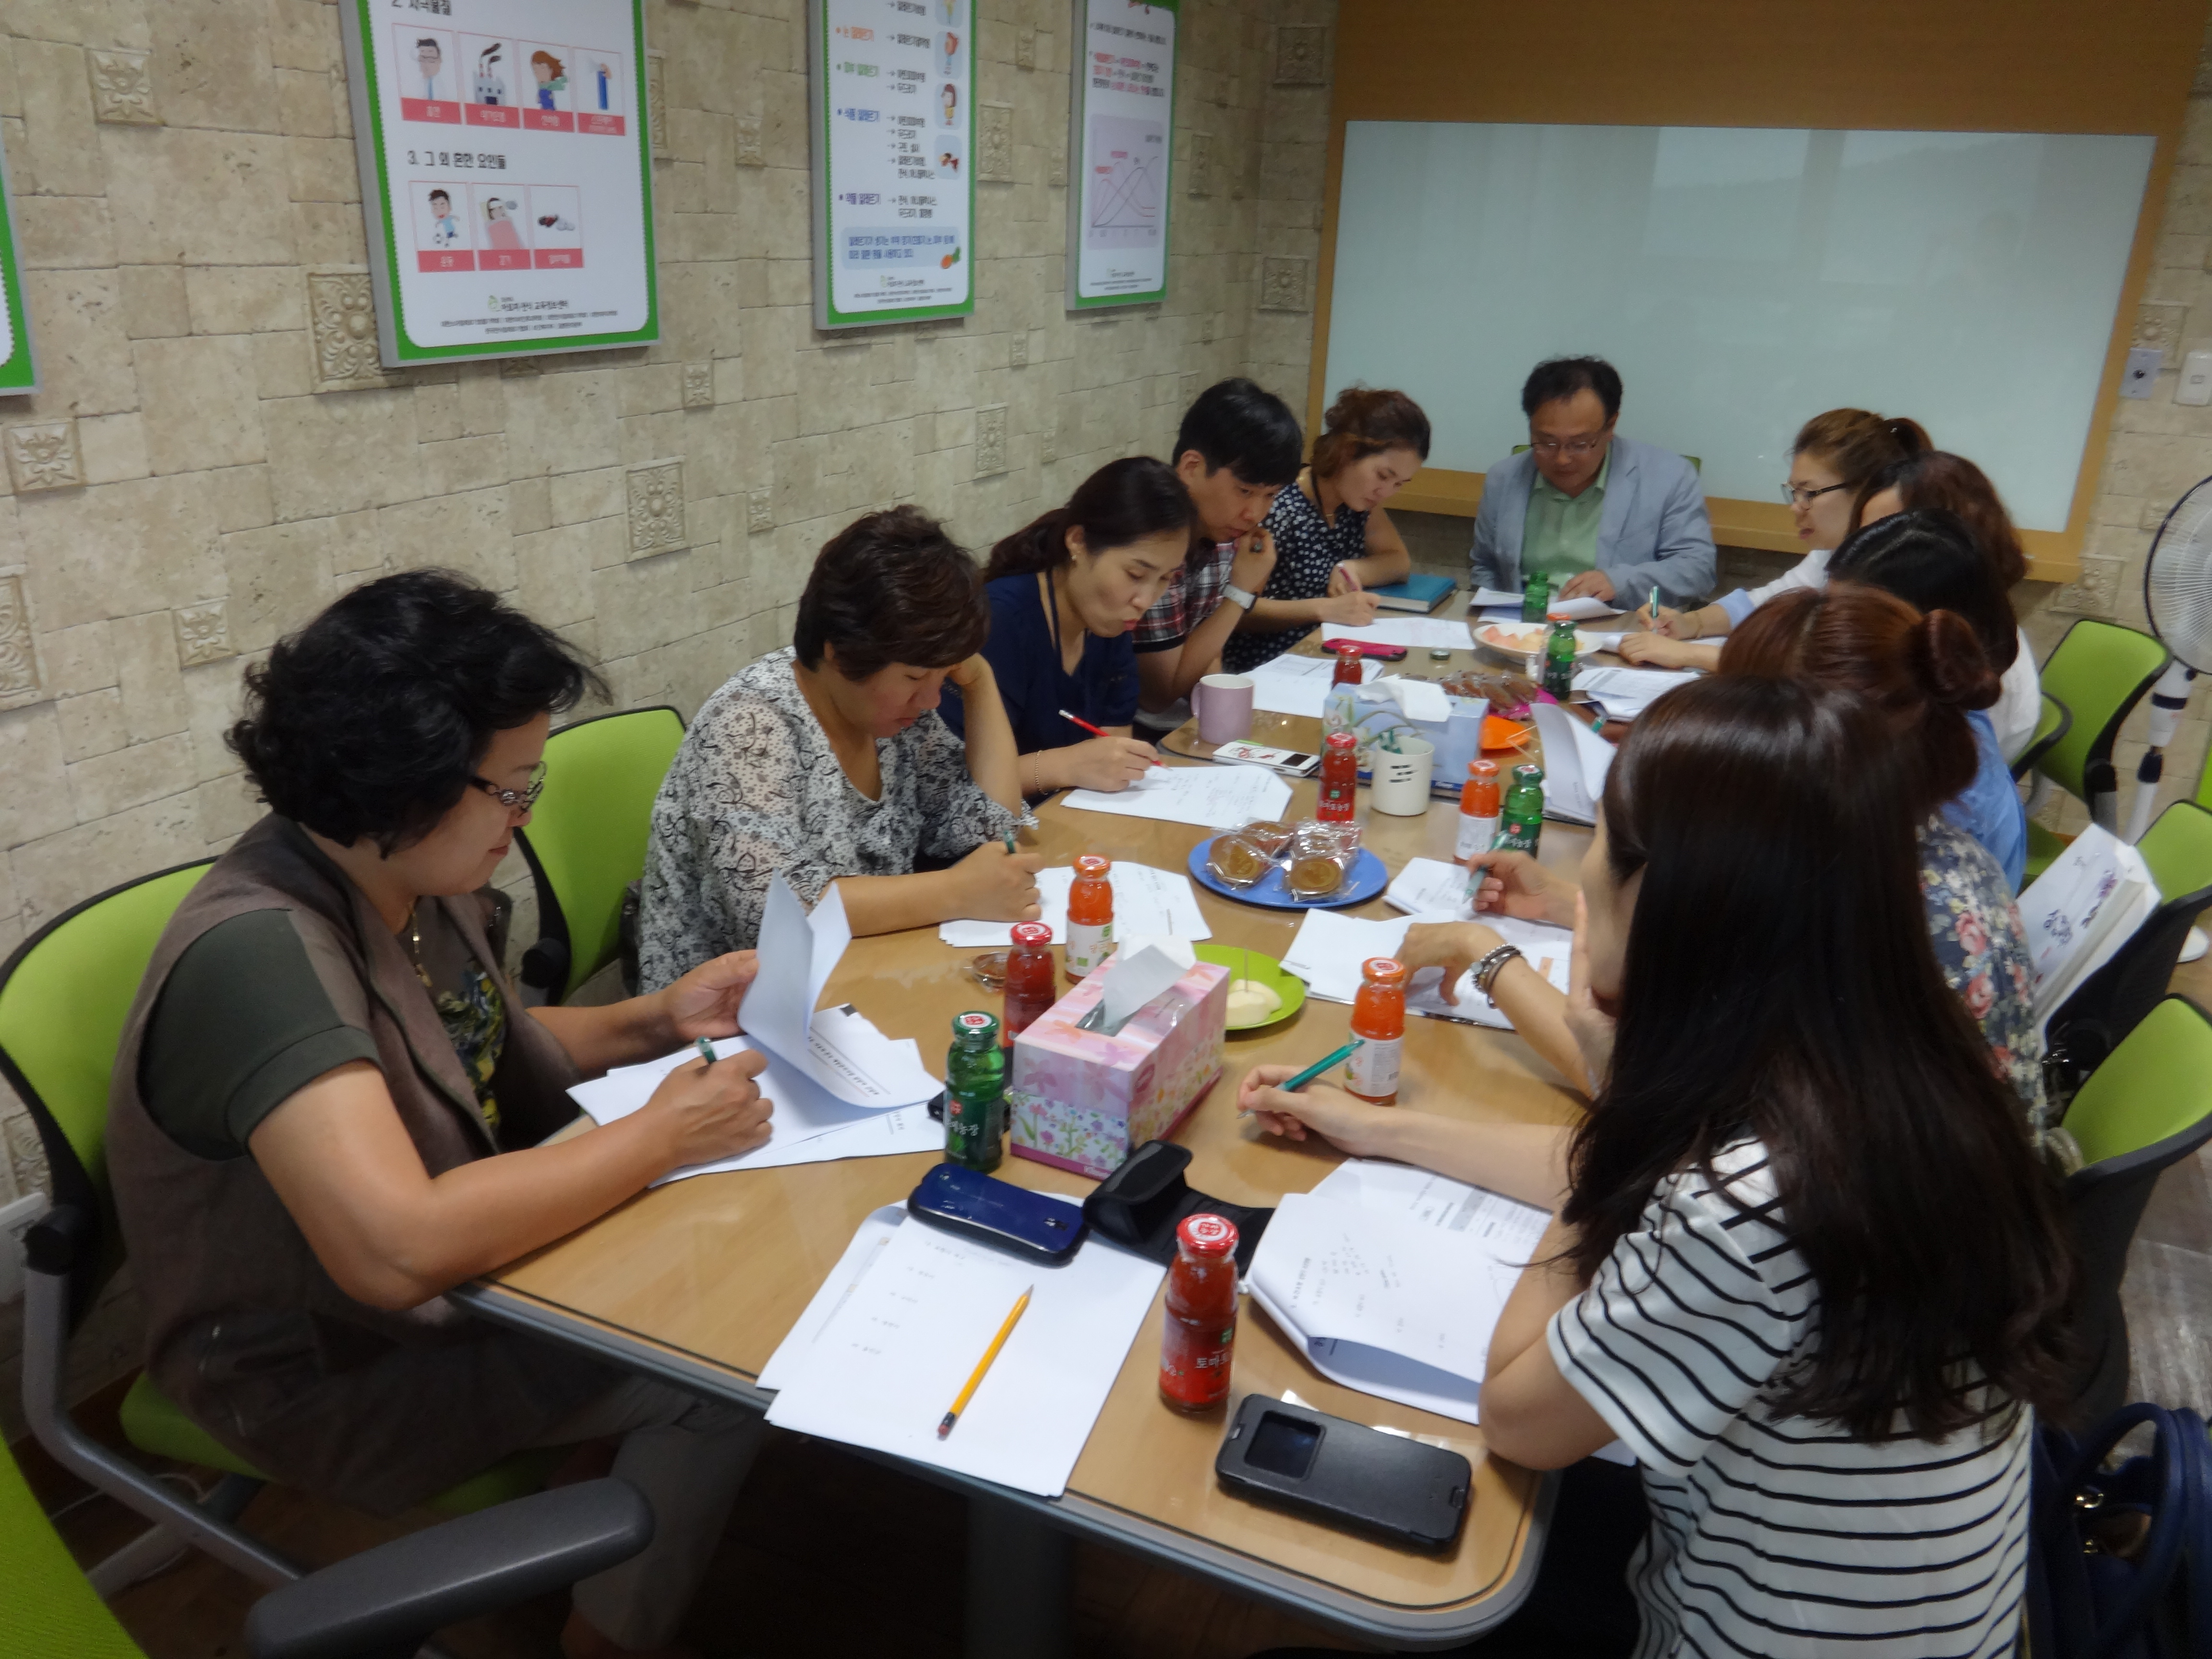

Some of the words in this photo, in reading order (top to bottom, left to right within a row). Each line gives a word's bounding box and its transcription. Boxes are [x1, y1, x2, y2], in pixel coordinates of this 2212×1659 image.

[424, 151, 434, 166] 그
[439, 152, 450, 167] 외
[477, 154, 506, 169] 요인들
